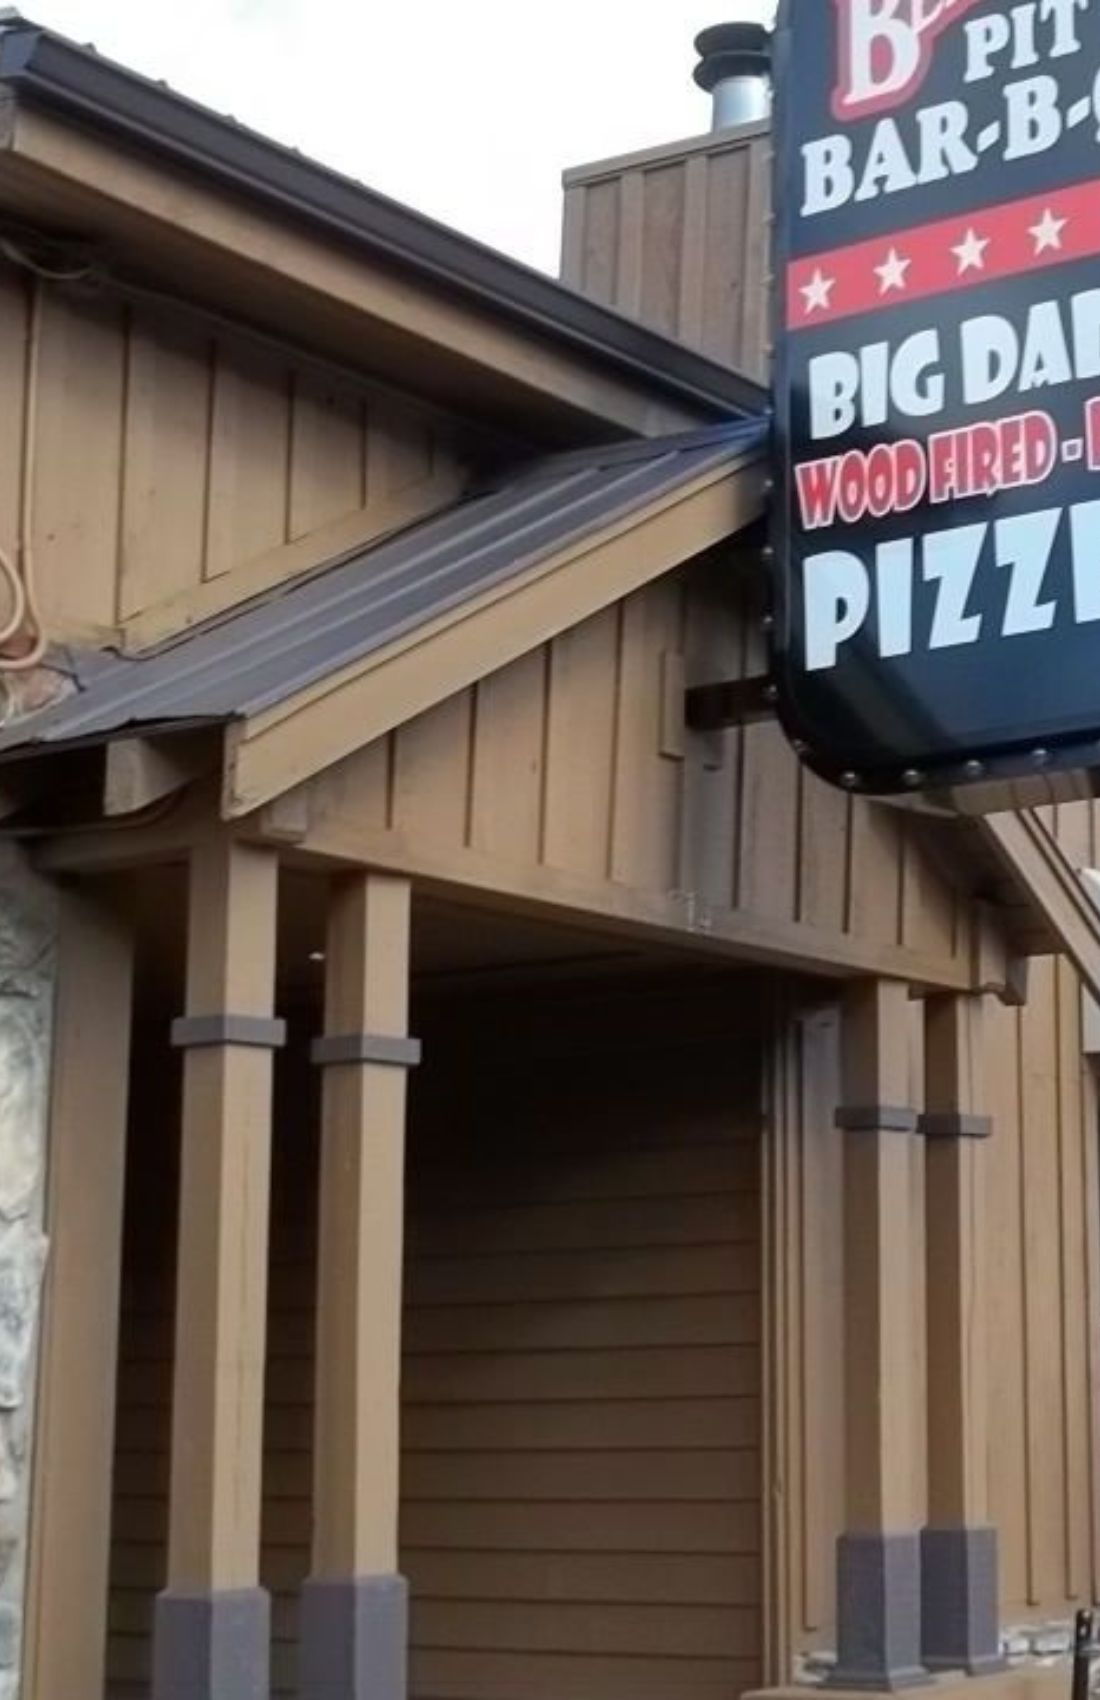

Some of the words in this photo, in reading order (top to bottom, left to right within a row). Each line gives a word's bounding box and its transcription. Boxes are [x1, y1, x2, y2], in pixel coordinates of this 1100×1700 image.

[964, 0, 1088, 83] PIT
[809, 328, 944, 440] BIG
[795, 440, 926, 530] WOOD
[929, 411, 1056, 503] FIRED
